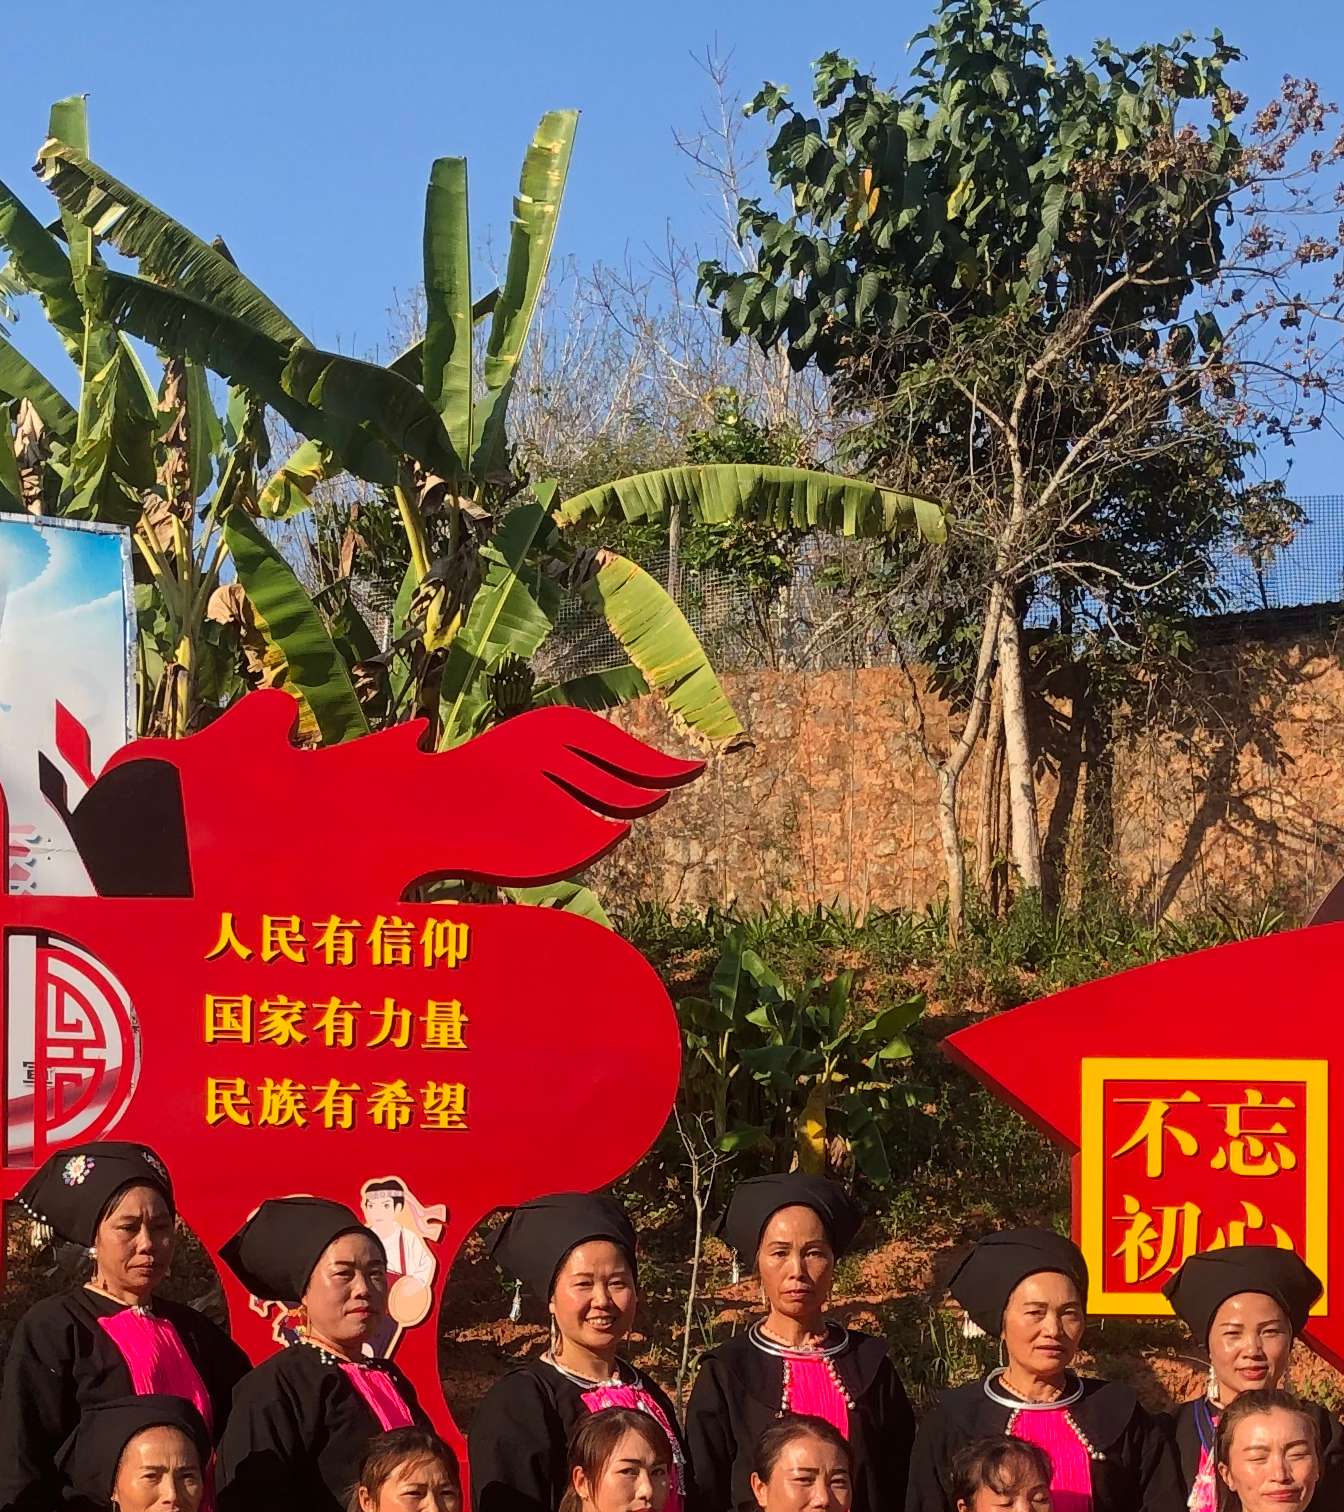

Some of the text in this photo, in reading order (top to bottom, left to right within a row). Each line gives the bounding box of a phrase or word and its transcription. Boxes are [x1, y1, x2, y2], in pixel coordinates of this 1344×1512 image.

[206, 912, 470, 968] 人民有信仰
[205, 994, 469, 1049] 国家有力量
[206, 1077, 469, 1131] 民族有希望
[1112, 1088, 1296, 1178] 不忘
